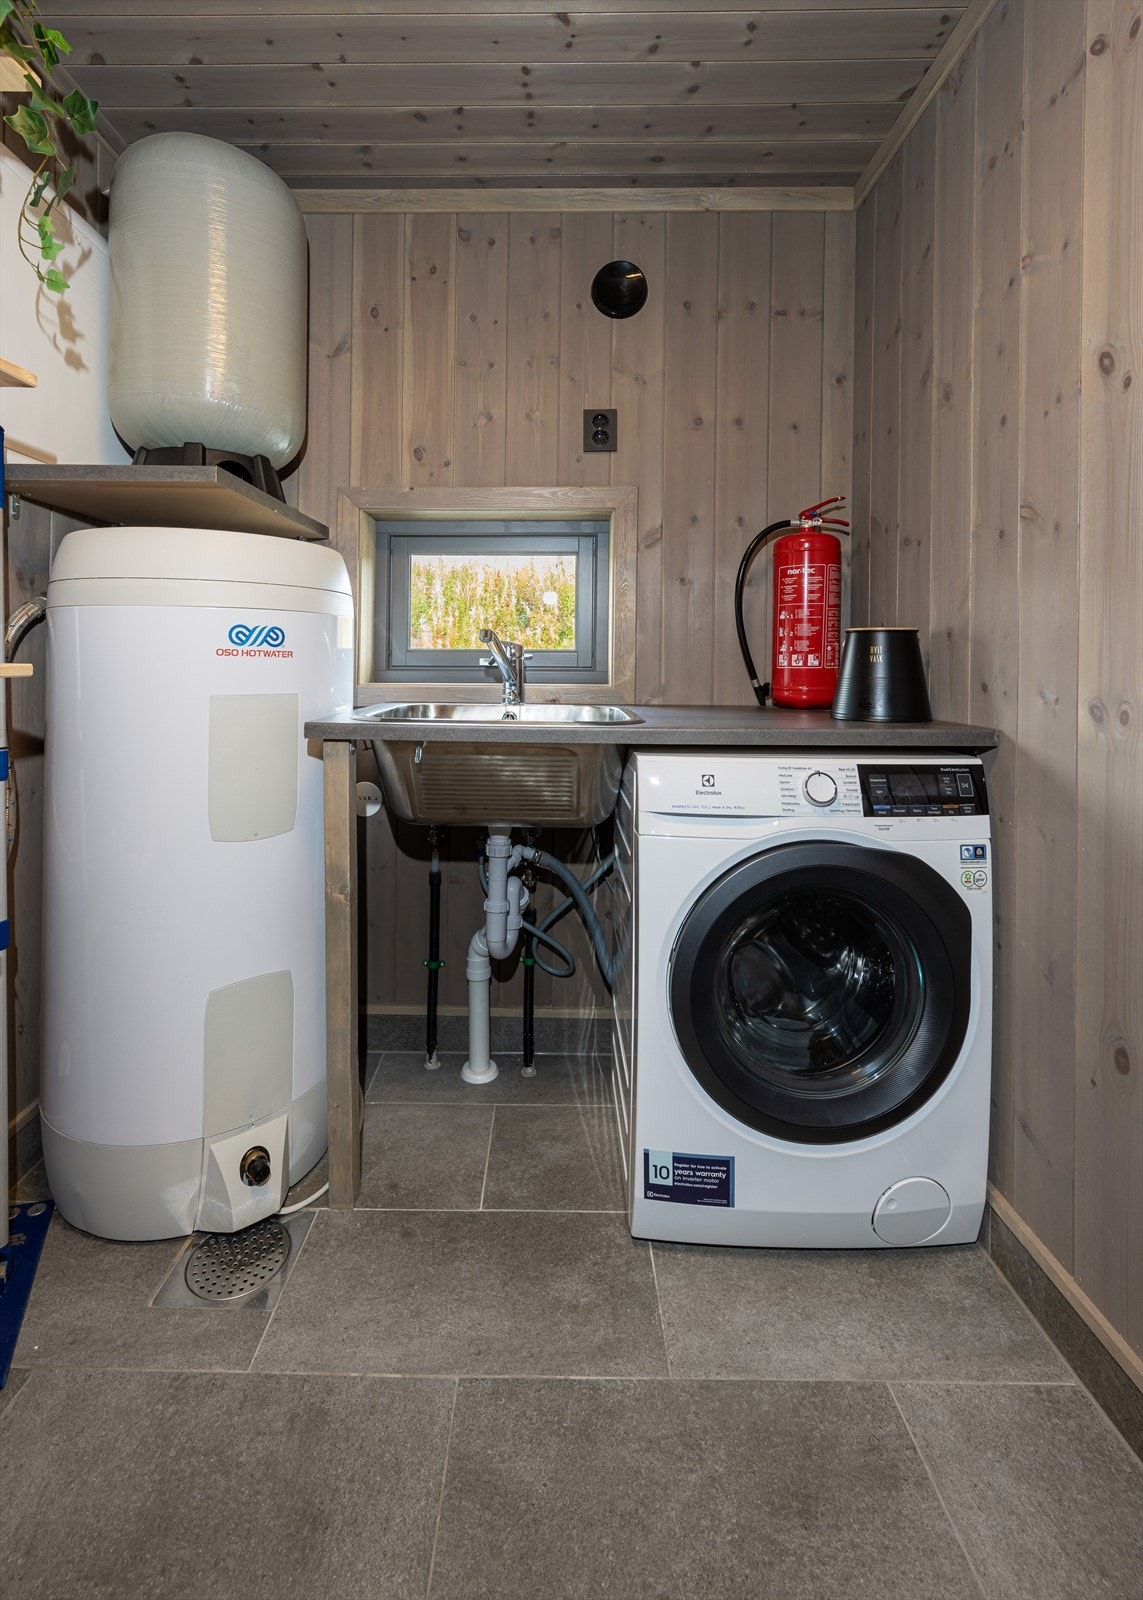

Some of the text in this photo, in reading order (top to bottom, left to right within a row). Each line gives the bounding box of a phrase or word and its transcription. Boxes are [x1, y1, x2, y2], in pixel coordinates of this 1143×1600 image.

[216, 648, 294, 658] OSO HOTWATER
[652, 1165, 670, 1179] 10
[695, 1171, 726, 1179] warranty
